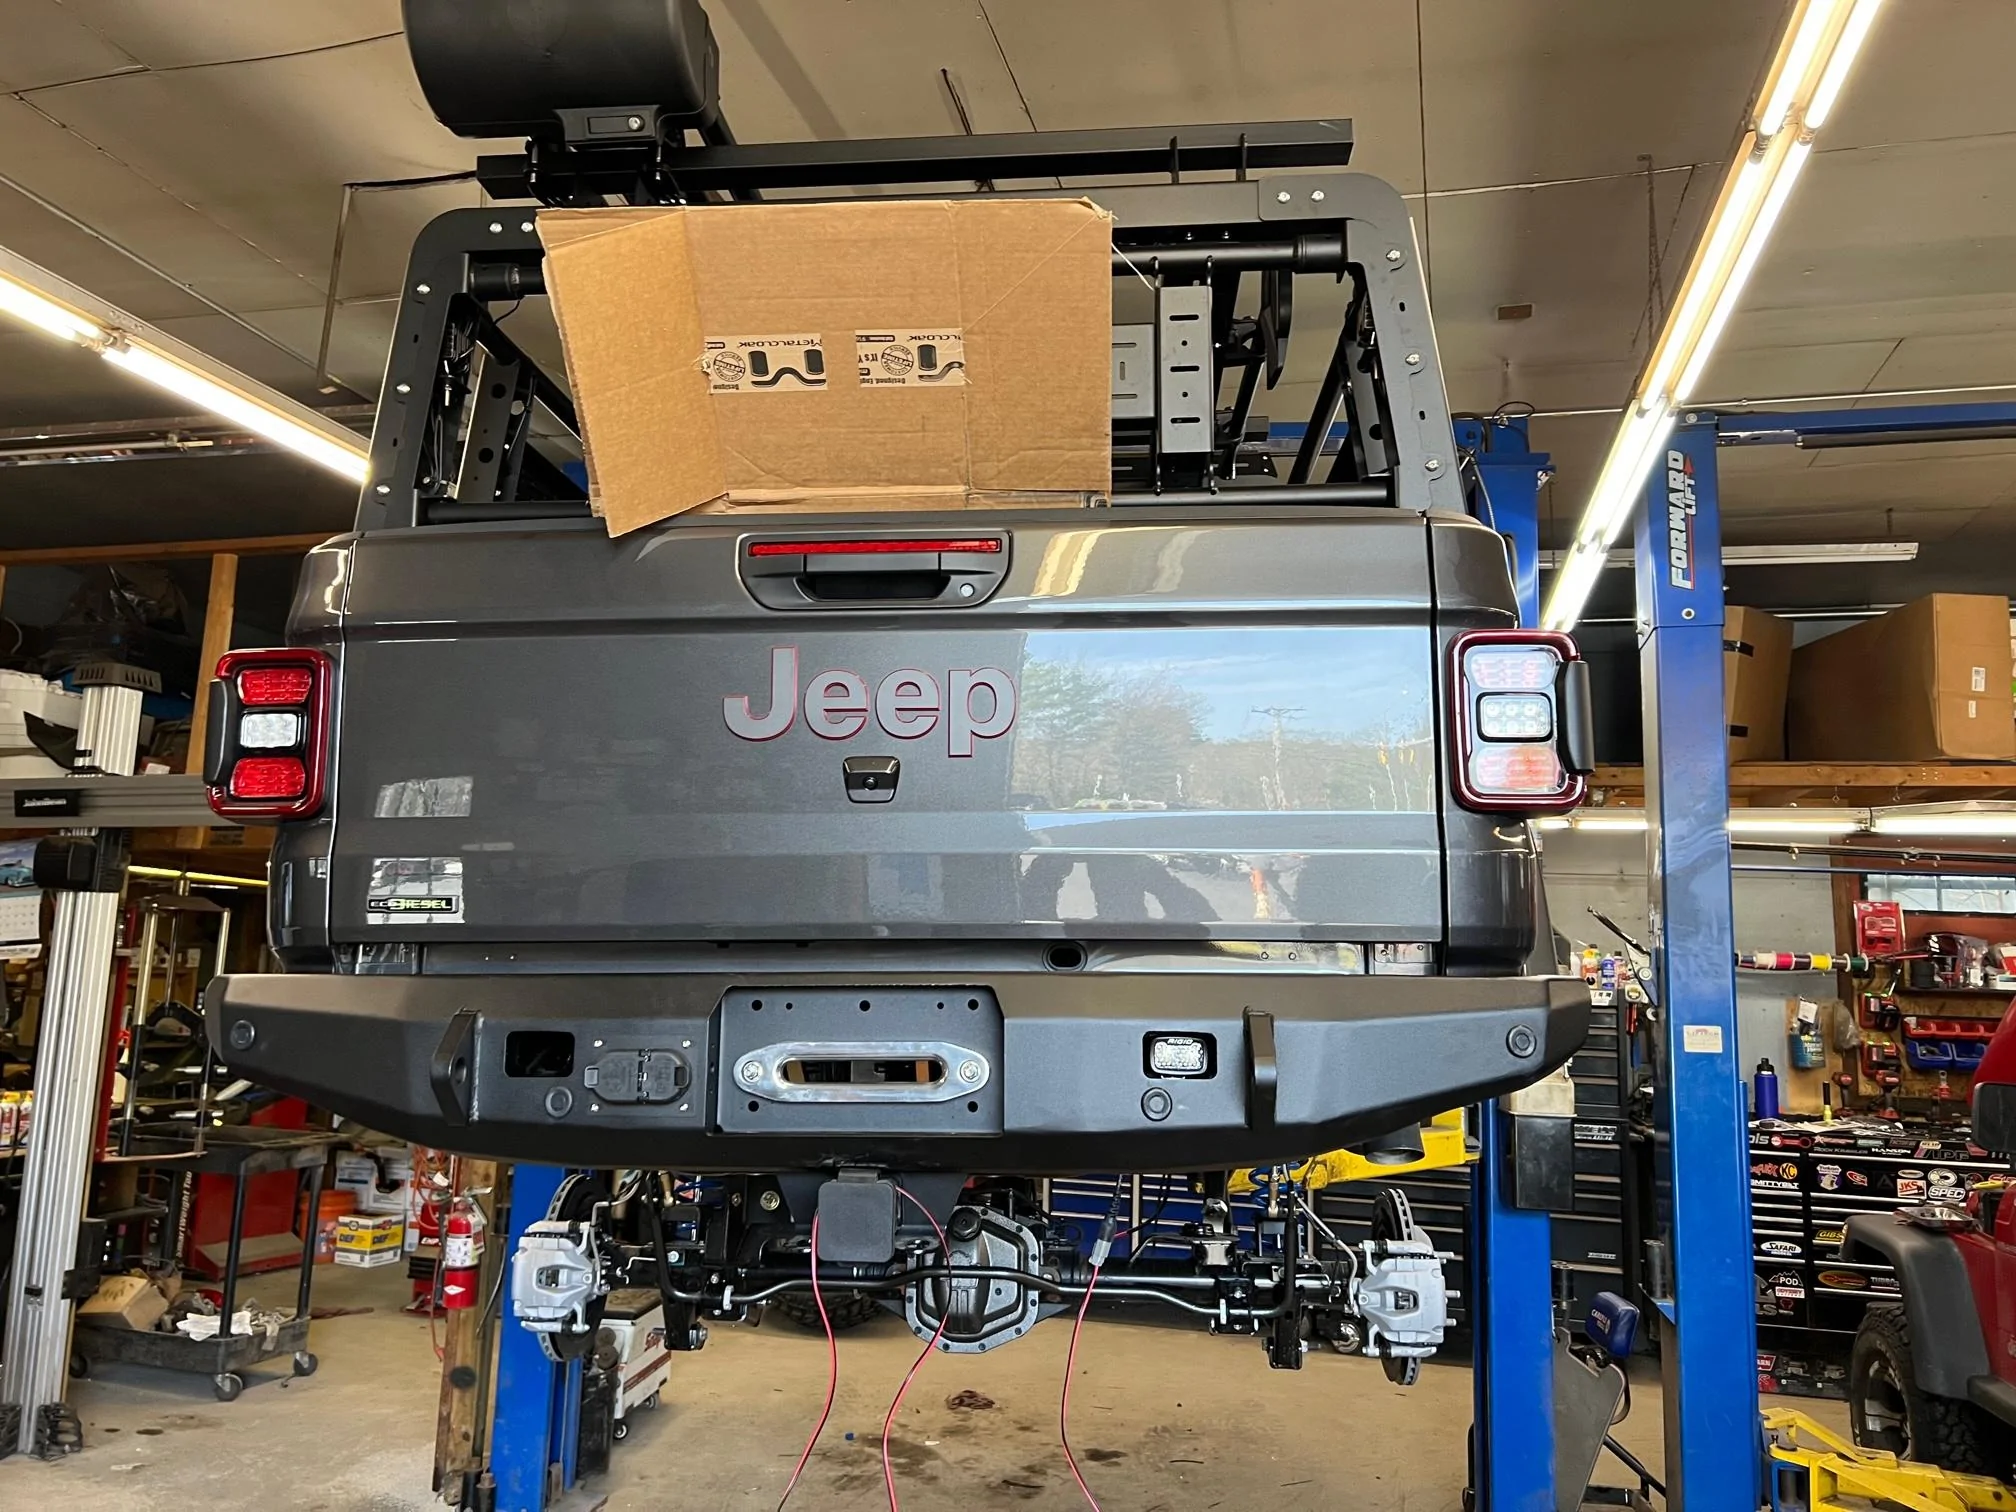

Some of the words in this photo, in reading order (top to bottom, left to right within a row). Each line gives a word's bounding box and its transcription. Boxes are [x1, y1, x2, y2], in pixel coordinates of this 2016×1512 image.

[1668, 450, 1694, 590] FORWARD
[722, 645, 1019, 758] Jeep
[1781, 1164, 1797, 1178] KC
[1899, 1181, 1919, 1191] JKS
[1929, 1187, 1966, 1199] SPEC
[1779, 1277, 1799, 1286] POD
